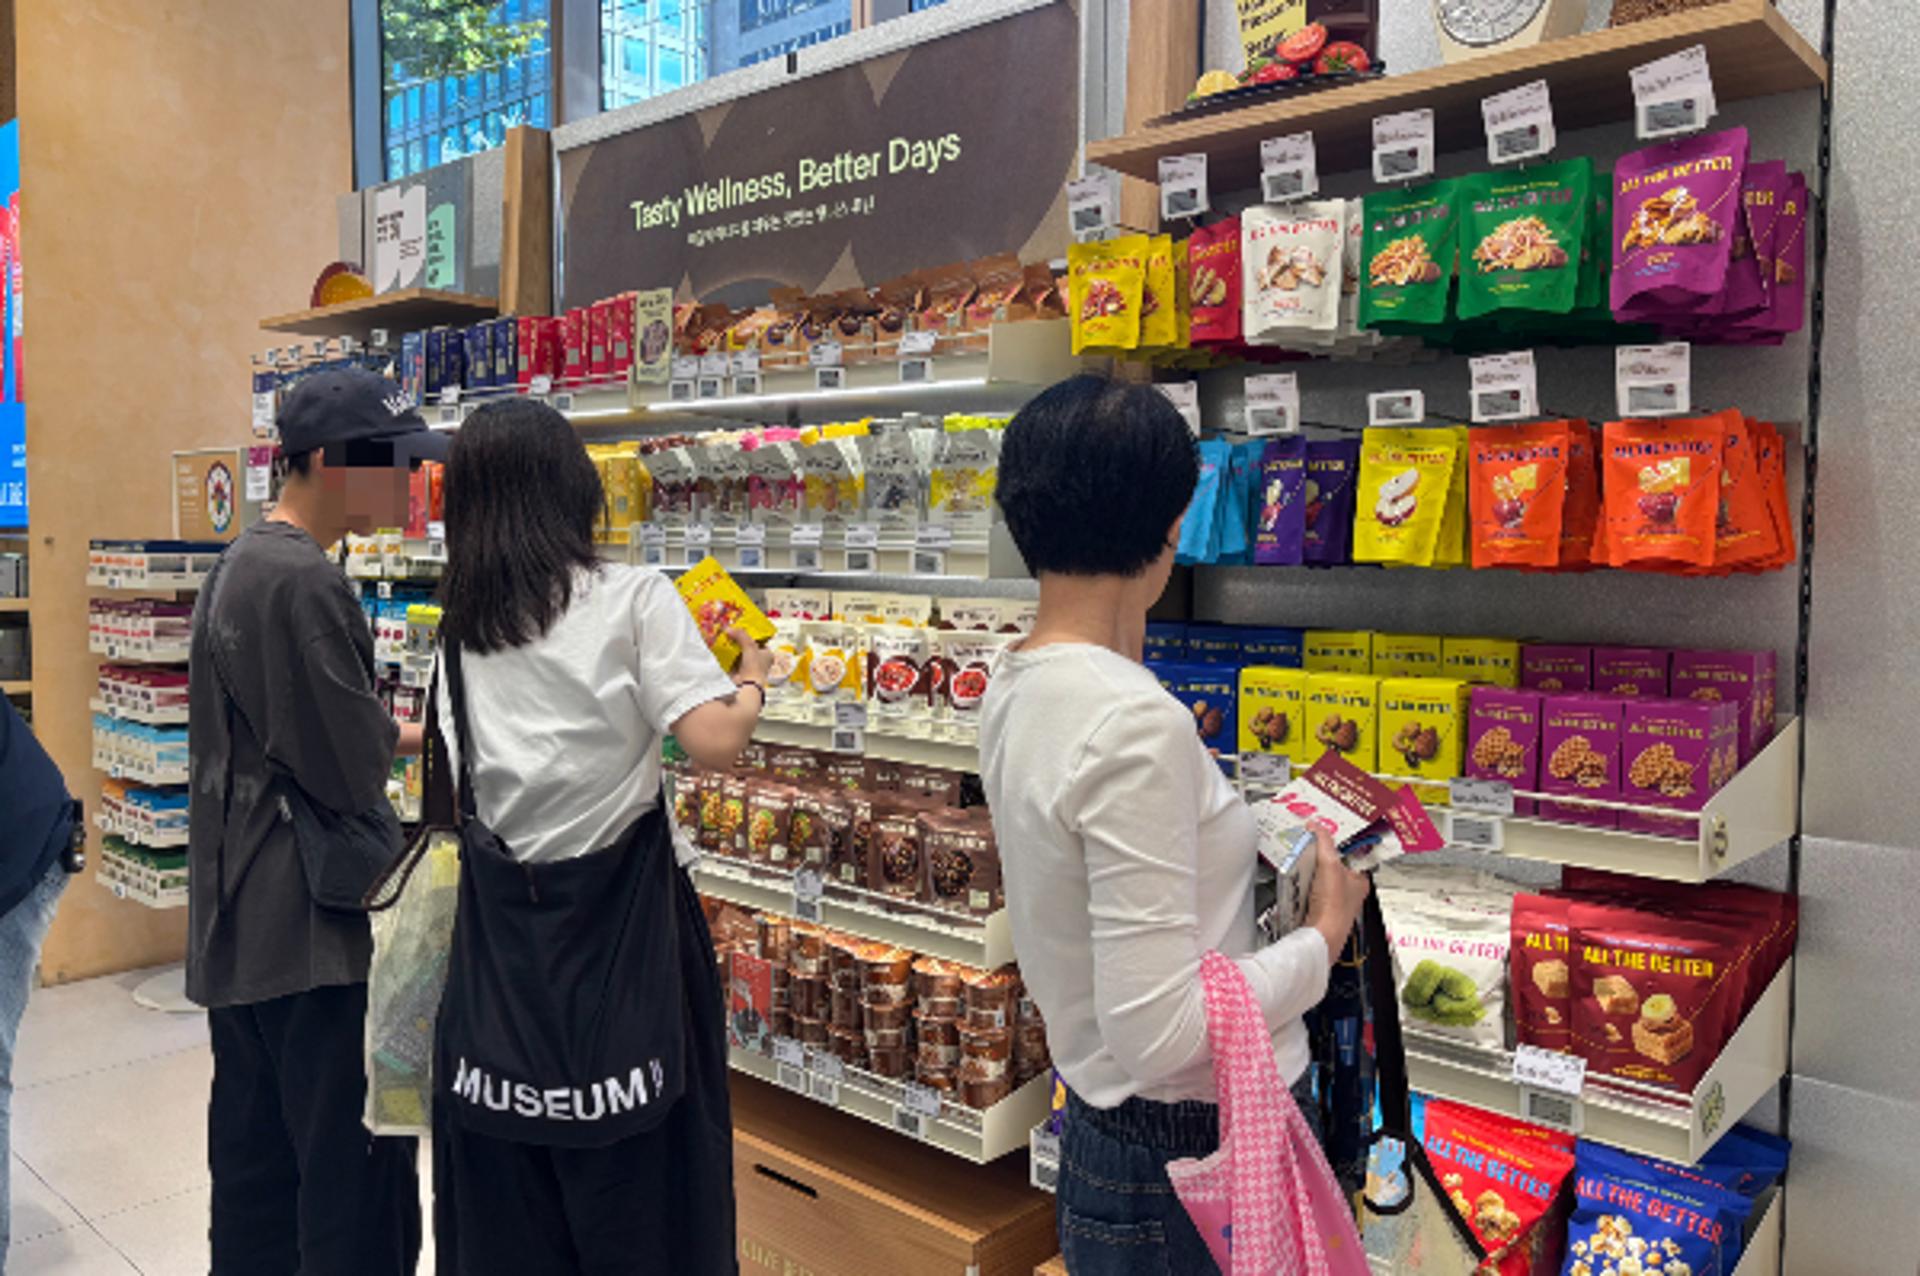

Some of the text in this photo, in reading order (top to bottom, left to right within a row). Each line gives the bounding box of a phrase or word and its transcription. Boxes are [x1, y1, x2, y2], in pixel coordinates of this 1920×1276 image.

[630, 193, 682, 231] Tasty
[685, 172, 792, 215] Wellness,
[799, 151, 881, 191] Better
[888, 133, 962, 174] Days
[1524, 932, 1552, 951] ALL
[1583, 945, 1714, 978] ALL THE BETTER
[451, 1056, 649, 1121] MUSEUM
[1426, 1135, 1451, 1158] ALL
[1455, 1145, 1485, 1172] THE
[1487, 1159, 1551, 1200] BETTER
[1574, 1176, 1605, 1201] ALL
[1608, 1183, 1642, 1213] THE
[1647, 1198, 1723, 1245] BETTER
